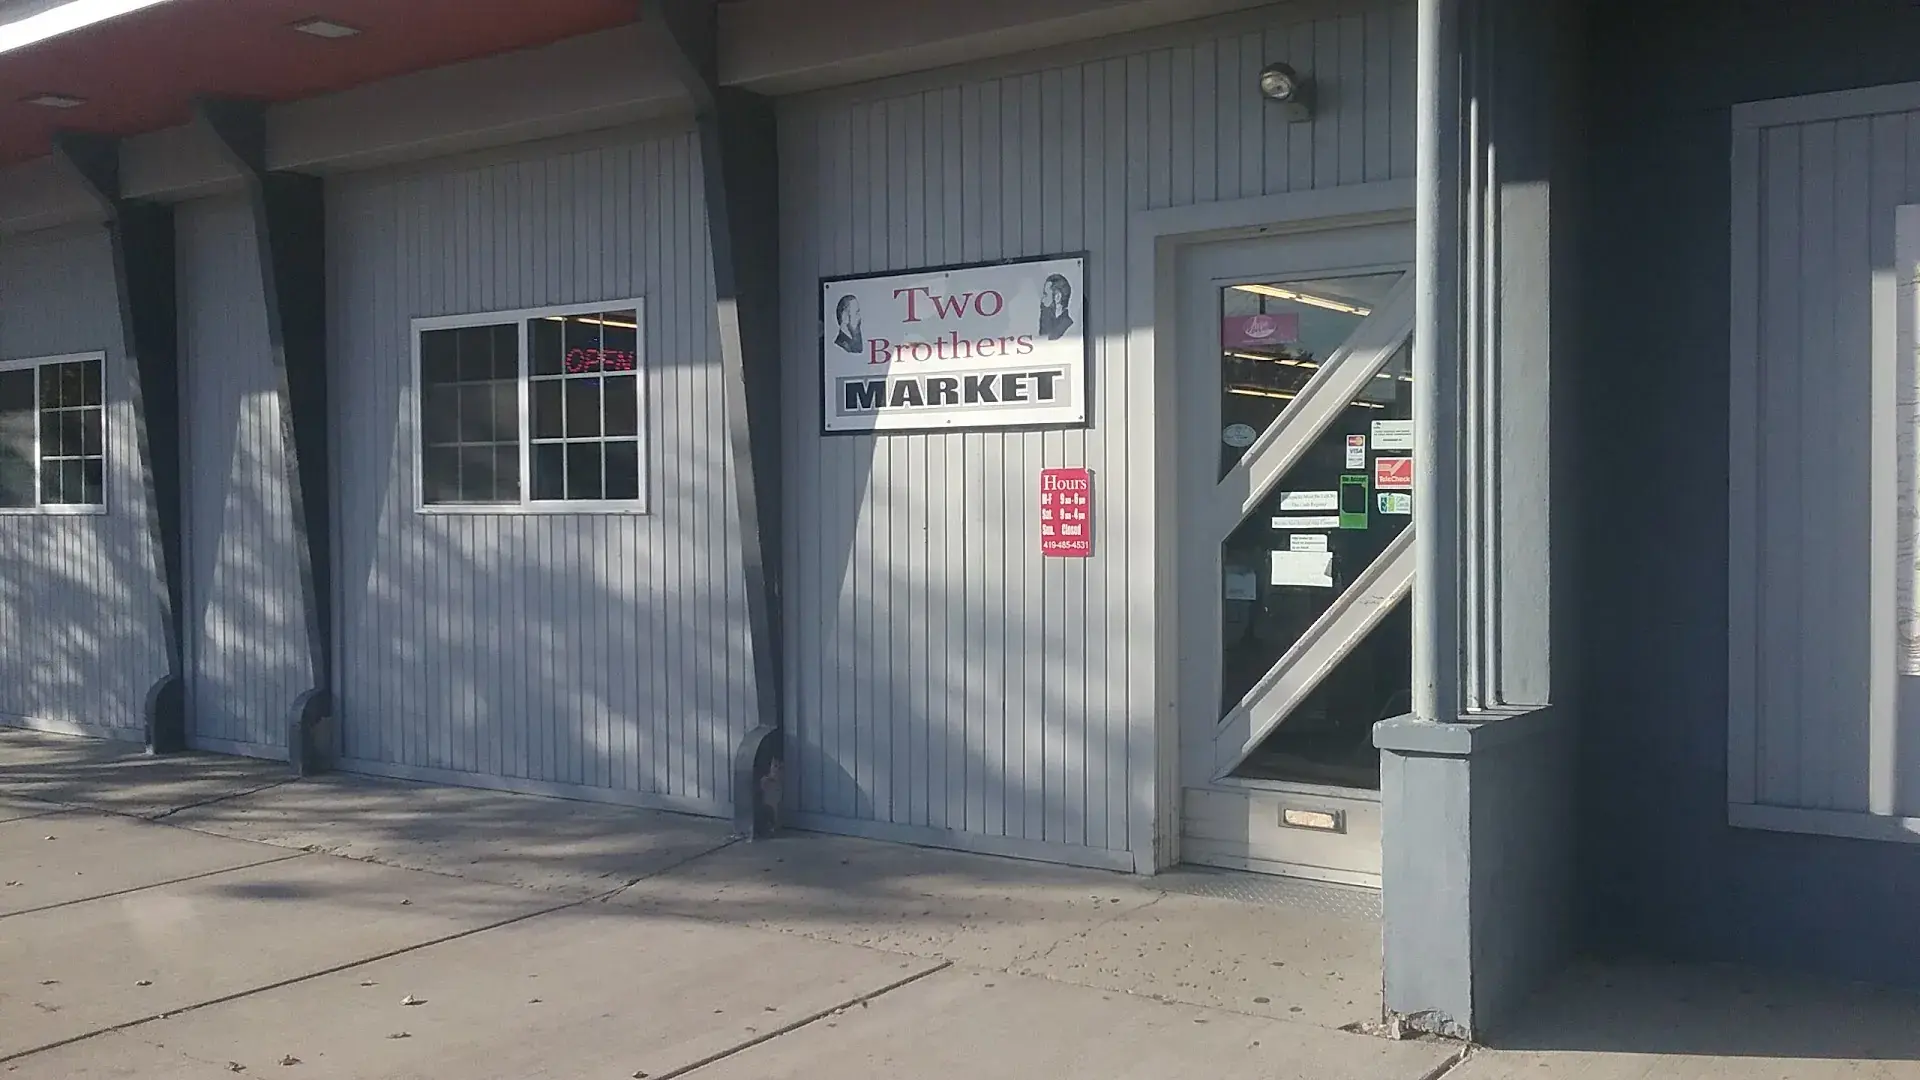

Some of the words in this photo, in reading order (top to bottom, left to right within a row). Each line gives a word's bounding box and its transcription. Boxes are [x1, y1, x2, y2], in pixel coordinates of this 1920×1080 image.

[893, 286, 1003, 323] Two
[566, 348, 634, 373] OPEN
[867, 331, 1034, 365] Brothers
[845, 370, 1062, 409] MARKET
[1043, 474, 1087, 491] Hours
[1061, 523, 1082, 536] Closed
[1043, 541, 1089, 549] 419-485-4531
